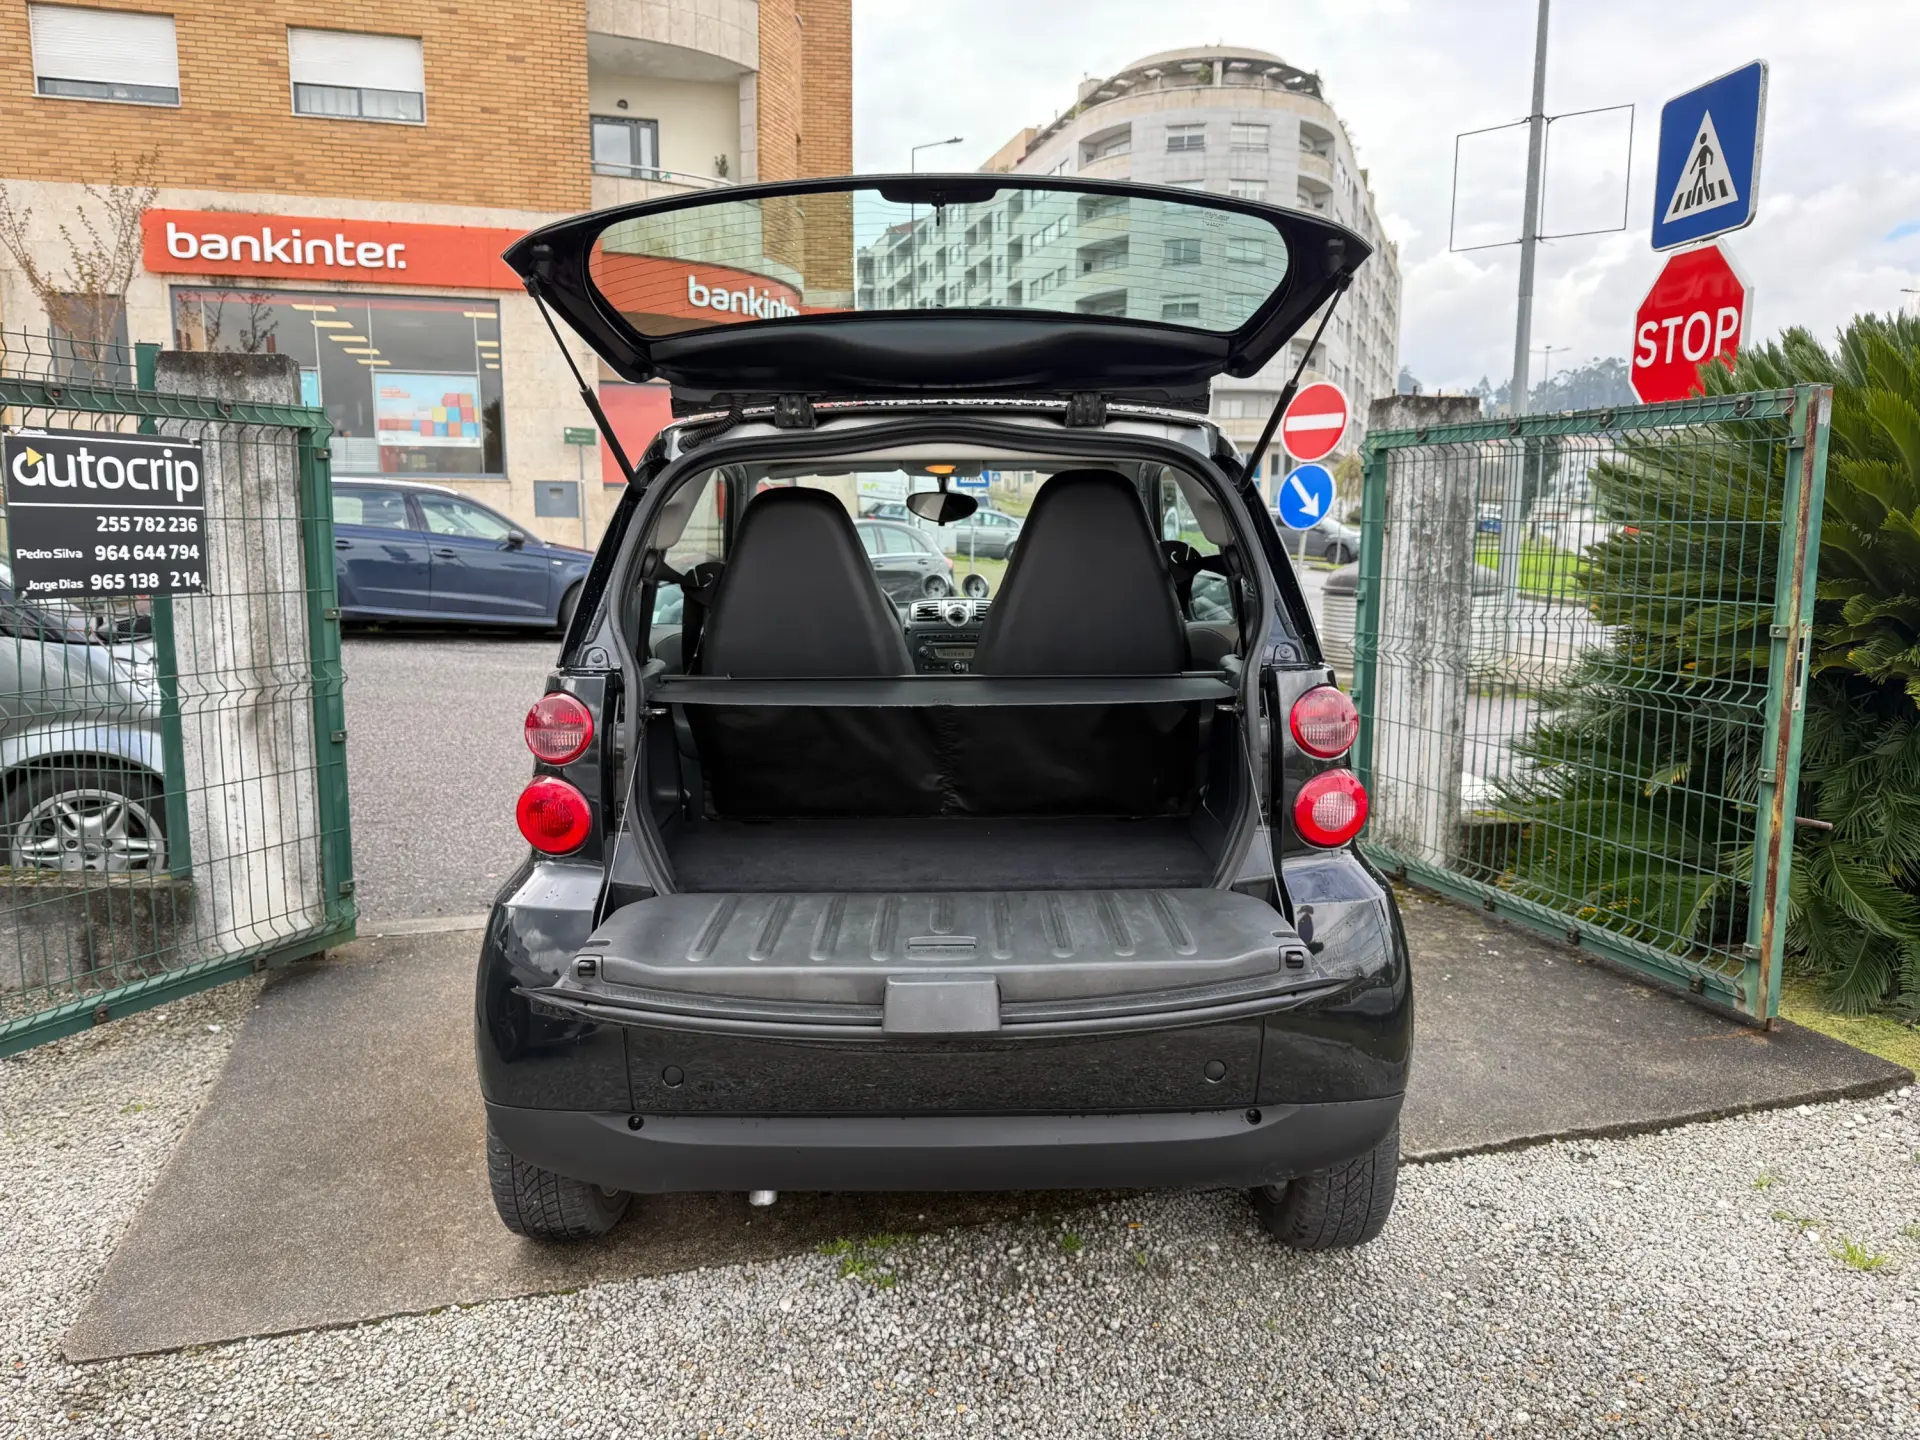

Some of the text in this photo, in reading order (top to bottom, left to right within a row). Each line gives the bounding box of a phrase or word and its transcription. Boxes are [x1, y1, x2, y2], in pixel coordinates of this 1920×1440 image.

[1635, 306, 1739, 368] STOP
[12, 446, 199, 502] autocrip
[96, 516, 198, 533] 255 782 236
[16, 544, 200, 561] Pedro Silva 964 644 794
[26, 579, 59, 592] Jorge
[59, 578, 84, 589] Dias
[90, 574, 125, 590] 965
[129, 572, 160, 589] 138
